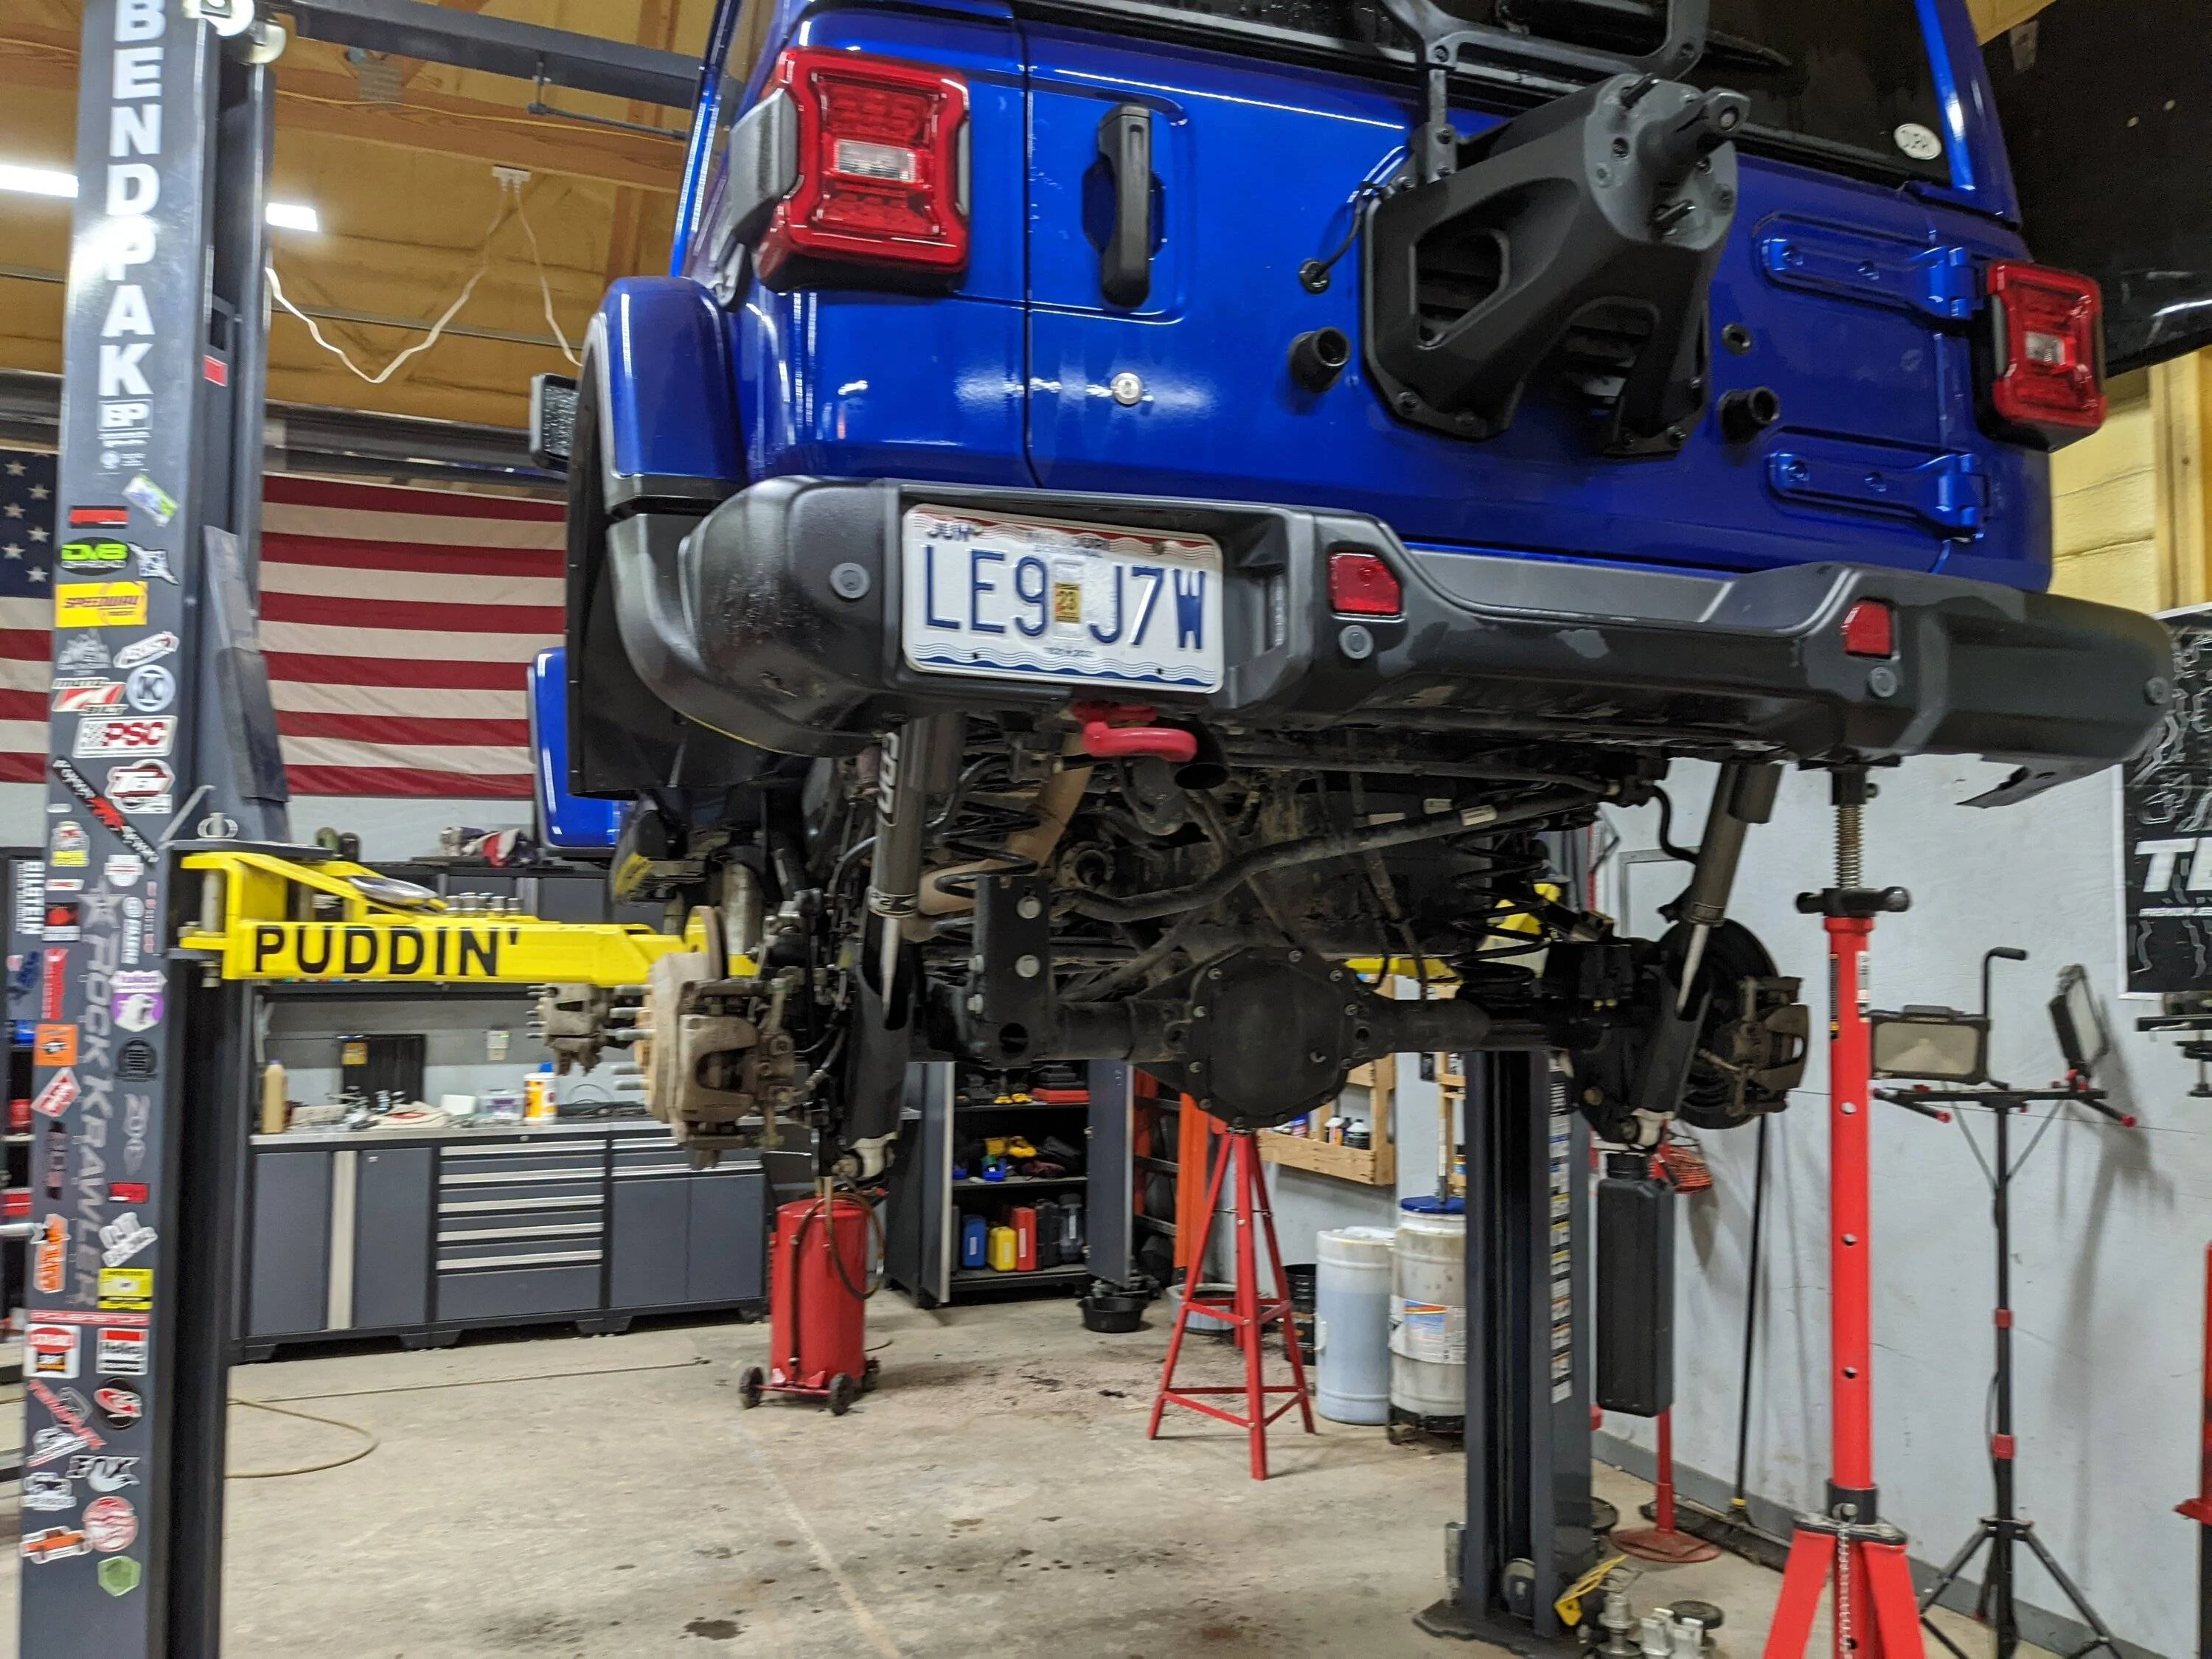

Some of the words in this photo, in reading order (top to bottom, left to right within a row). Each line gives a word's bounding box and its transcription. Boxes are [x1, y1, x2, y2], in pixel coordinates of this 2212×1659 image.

[98, 0, 167, 396] BENDPAK
[923, 544, 1048, 637] LE9
[1088, 564, 1206, 650] J7W
[254, 926, 521, 977] PUDDIN'
